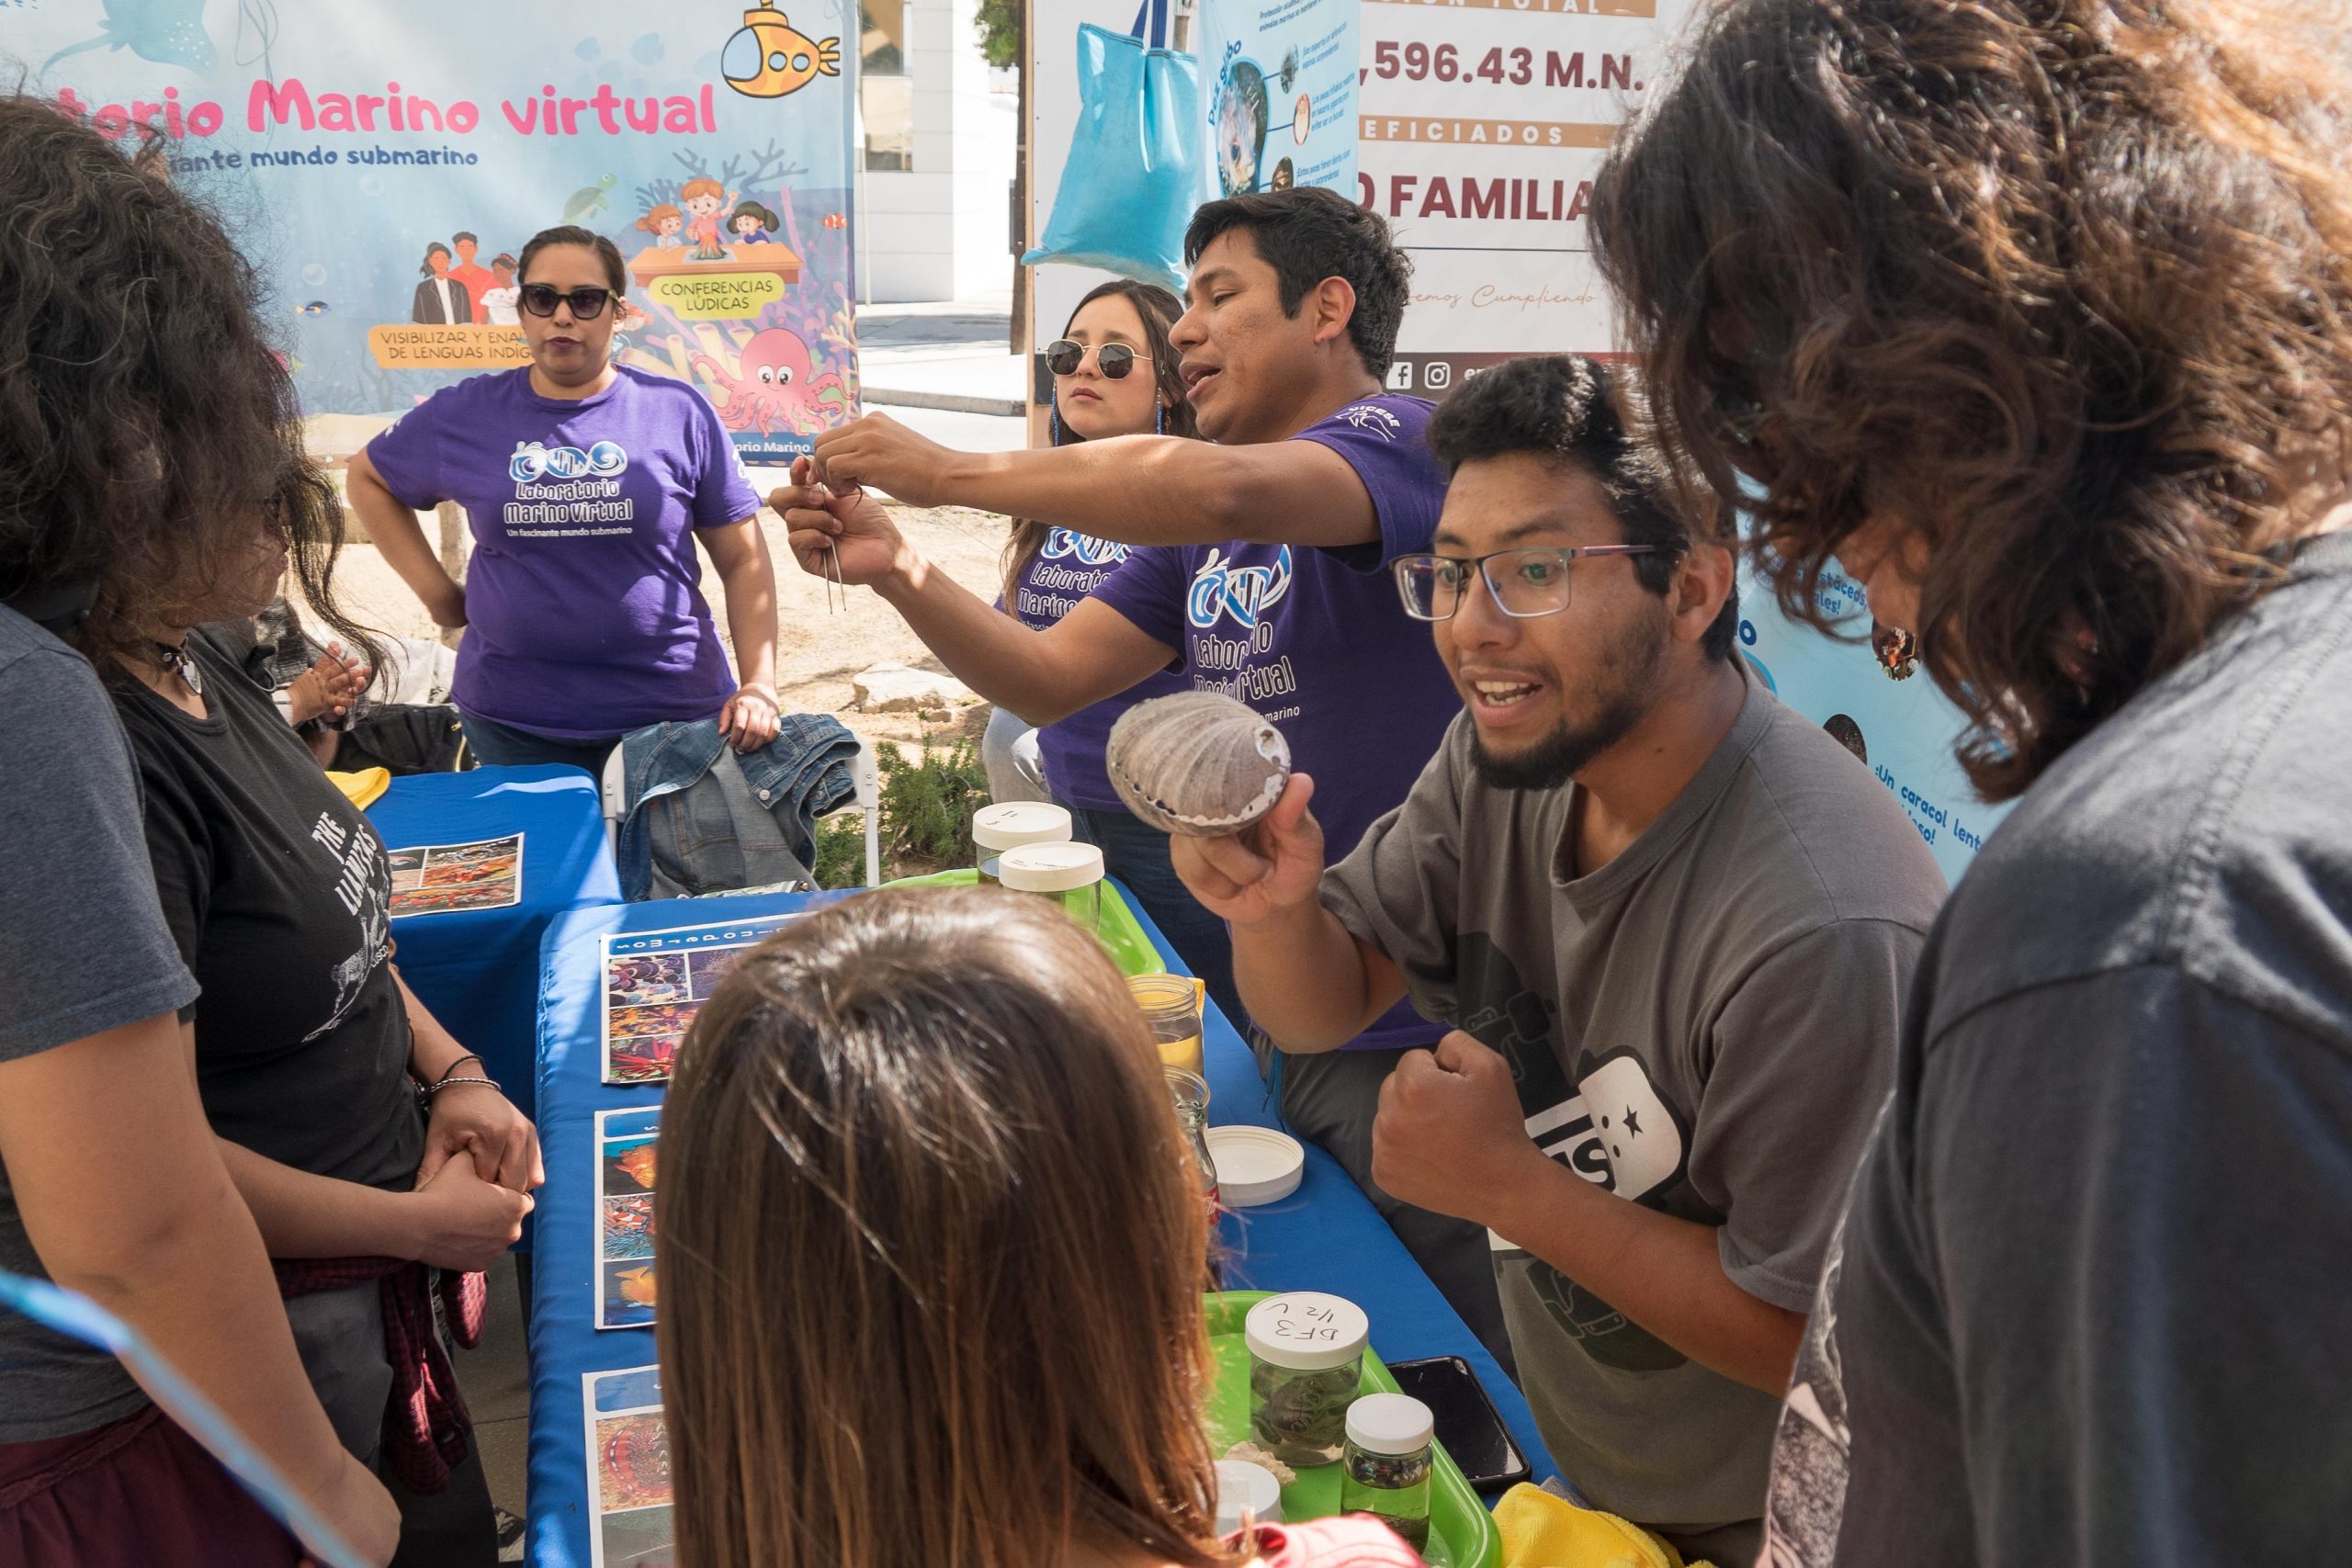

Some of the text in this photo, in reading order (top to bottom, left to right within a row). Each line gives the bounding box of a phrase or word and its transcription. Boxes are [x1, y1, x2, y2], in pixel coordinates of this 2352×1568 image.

[1545, 51, 1645, 91] M.N.
[247, 78, 480, 133] Marino
[502, 84, 718, 136] virtual
[1364, 119, 1563, 145] EFICIADOS
[251, 146, 338, 166] mundo
[346, 145, 478, 165] submarino
[661, 280, 773, 296] CONFERENCIAS
[1471, 282, 1598, 311] Cumpliendo
[686, 295, 750, 310] LÚDICAS
[379, 332, 467, 344] VISIBILIZAR
[472, 332, 482, 344] Y
[390, 347, 406, 359] DE
[413, 346, 483, 359] LENGUAS
[763, 441, 810, 453] Marino
[516, 478, 619, 501] Laboratorio
[503, 498, 633, 524] Marino Virtual
[519, 528, 560, 537] fascinante
[560, 527, 589, 536] mundo
[590, 526, 633, 536] submarino
[1901, 785, 1948, 828] caracol
[1953, 818, 1982, 852] lent
[311, 812, 346, 865] THE
